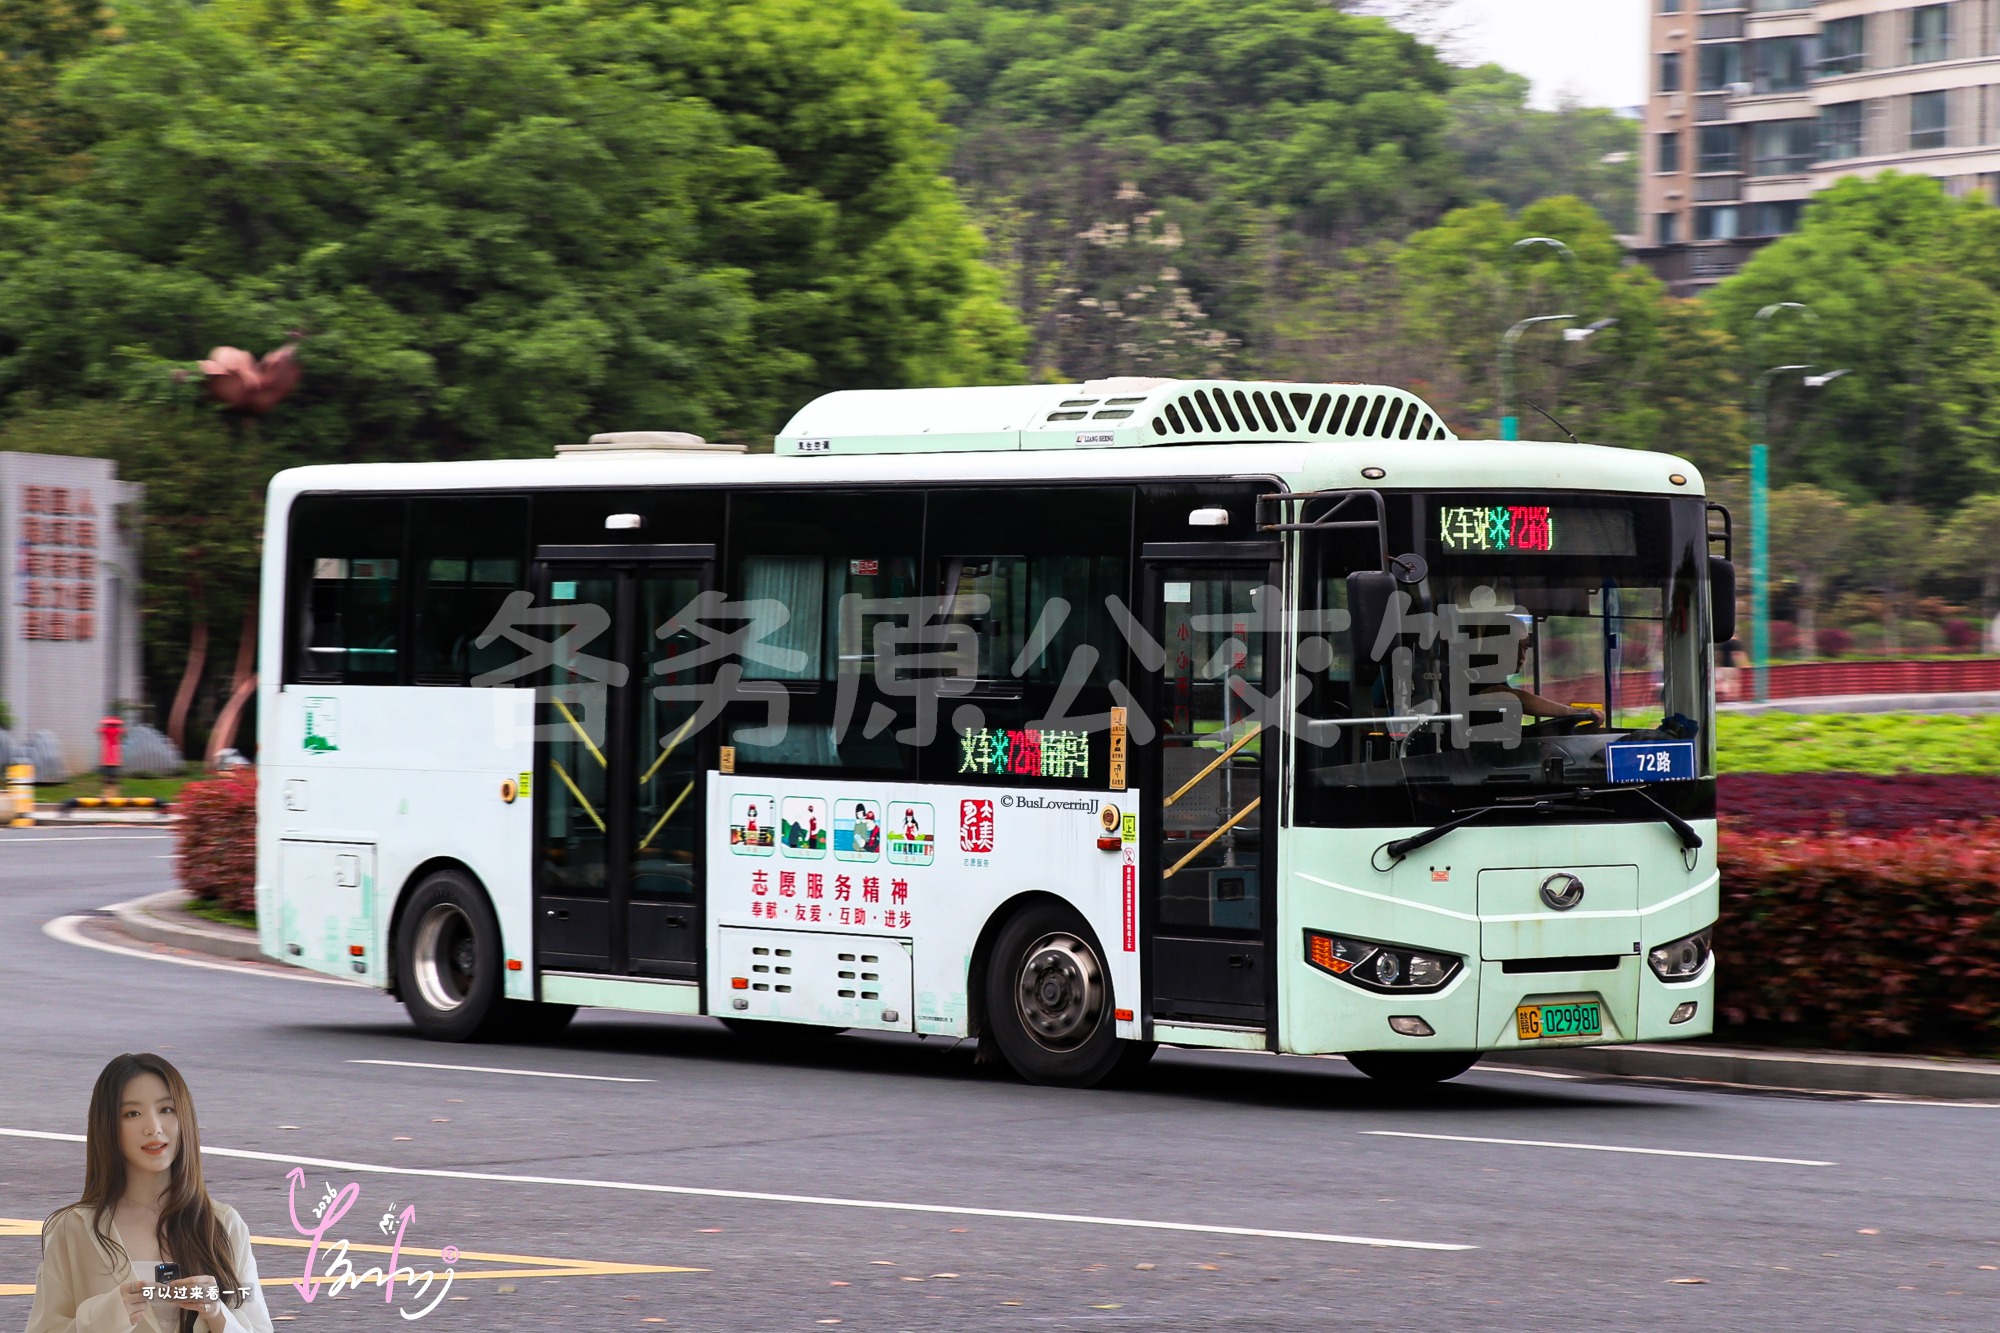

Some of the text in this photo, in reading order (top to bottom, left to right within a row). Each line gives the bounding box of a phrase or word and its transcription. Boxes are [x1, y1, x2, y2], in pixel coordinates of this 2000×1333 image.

[1636, 751, 1671, 773] 72路
[751, 869, 909, 905] 志愿服务精神
